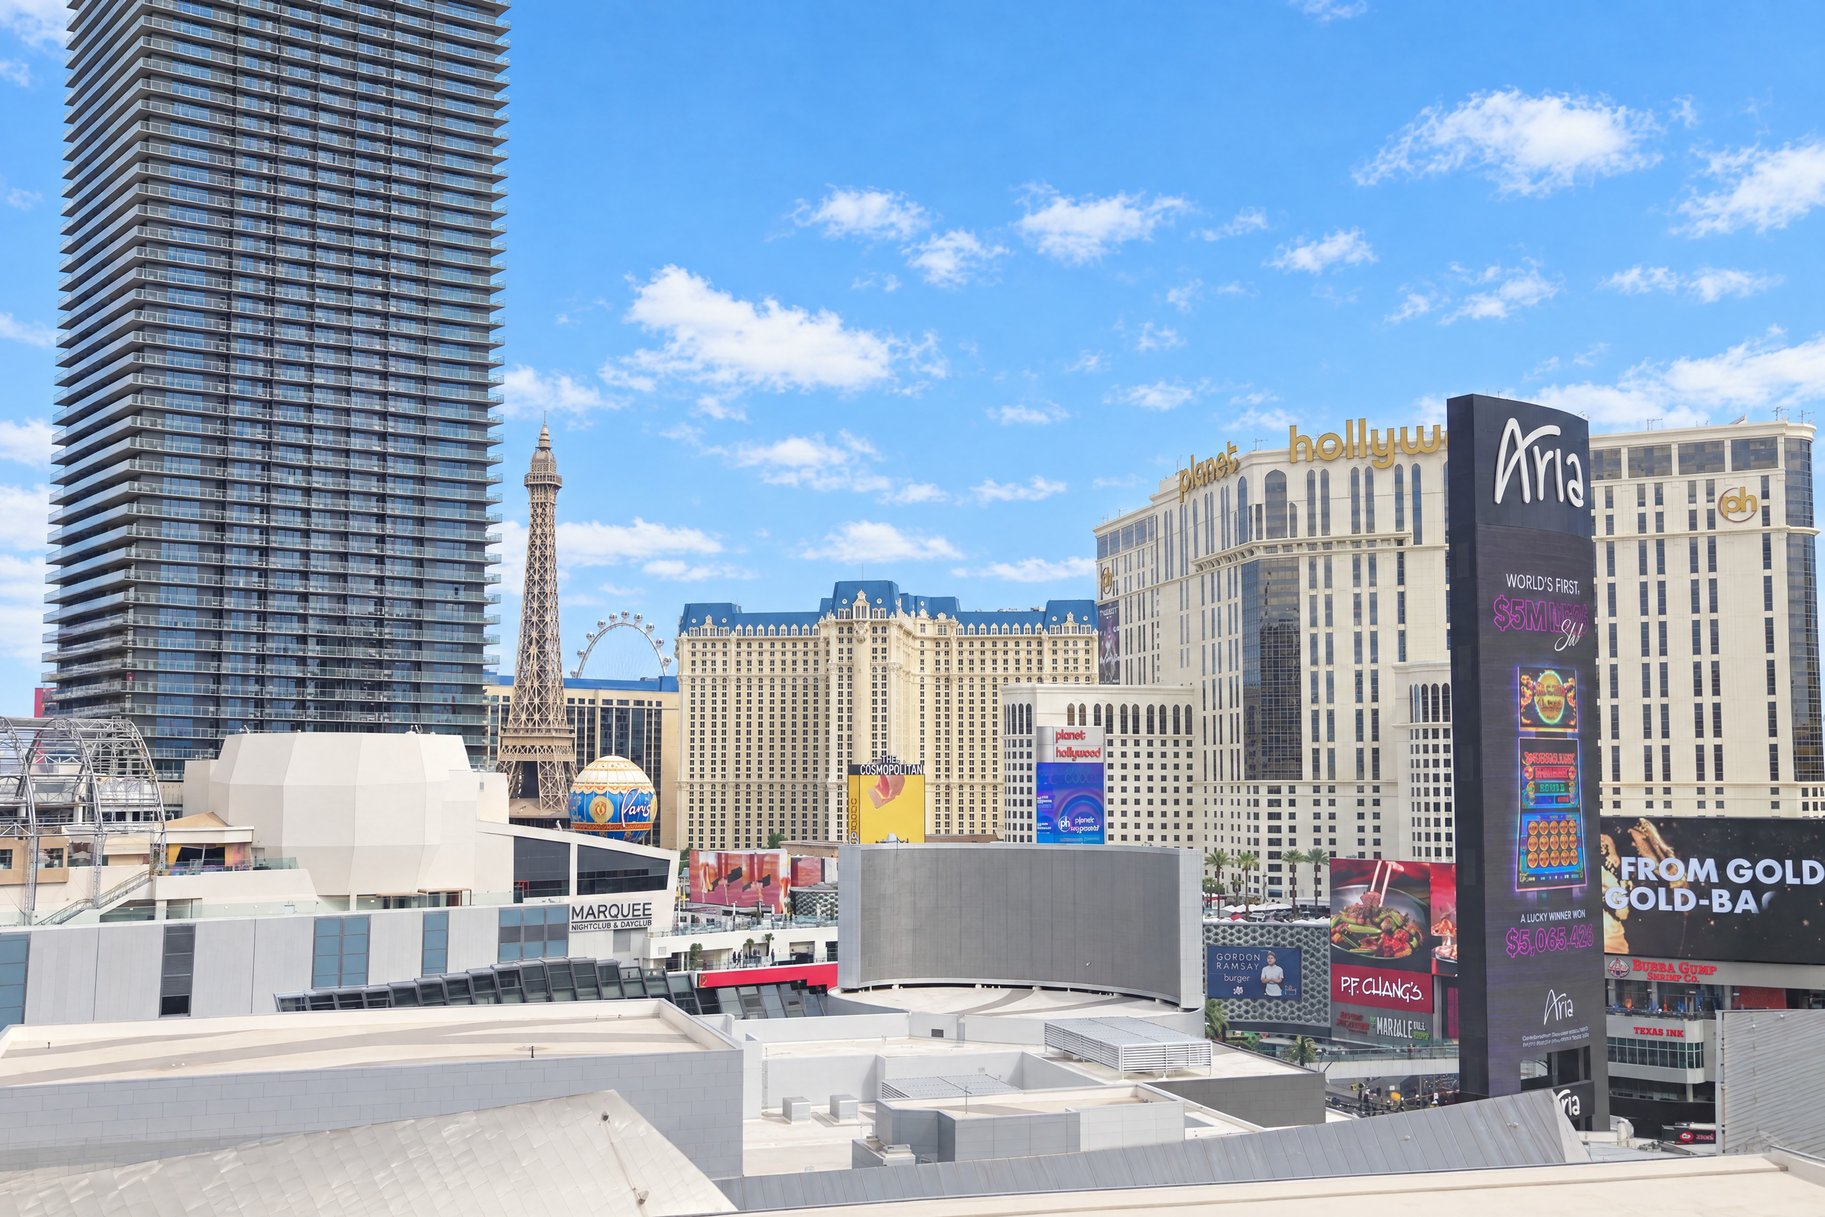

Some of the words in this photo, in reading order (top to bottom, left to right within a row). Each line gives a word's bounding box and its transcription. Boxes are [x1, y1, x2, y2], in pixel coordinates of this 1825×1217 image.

[1179, 440, 1239, 504] planet
[1289, 417, 1448, 470] hollyw
[1494, 417, 1584, 508] Aria
[1505, 573, 1554, 592] WORLD'S
[1055, 729, 1087, 743] planet
[881, 755, 897, 764] THE
[1056, 746, 1101, 761] hollywood
[860, 764, 924, 775] COSMOPOLITAN
[621, 787, 651, 828] Paris
[1620, 856, 1720, 883] FROM
[1726, 857, 1825, 886] GOLD
[571, 902, 653, 921] MARQUEE
[1520, 914, 1526, 923] A
[1527, 912, 1548, 923] LUCKY
[1548, 910, 1572, 921] WINNER
[1572, 908, 1586, 919] WON
[571, 922, 612, 931] NIGHTCLUB
[613, 921, 619, 929] &
[620, 919, 653, 928] DAYCLUB
[1216, 953, 1260, 961] GORDON
[1216, 962, 1260, 971] RAMSAY
[1632, 958, 1676, 974] BUBBA
[1678, 961, 1717, 975] GUMP
[1224, 973, 1250, 983] burger
[1543, 988, 1574, 1026] Aria
[1633, 1026, 1664, 1036] TEXAS
[1665, 1029, 1685, 1038] INK
[1557, 1089, 1581, 1116] ria
